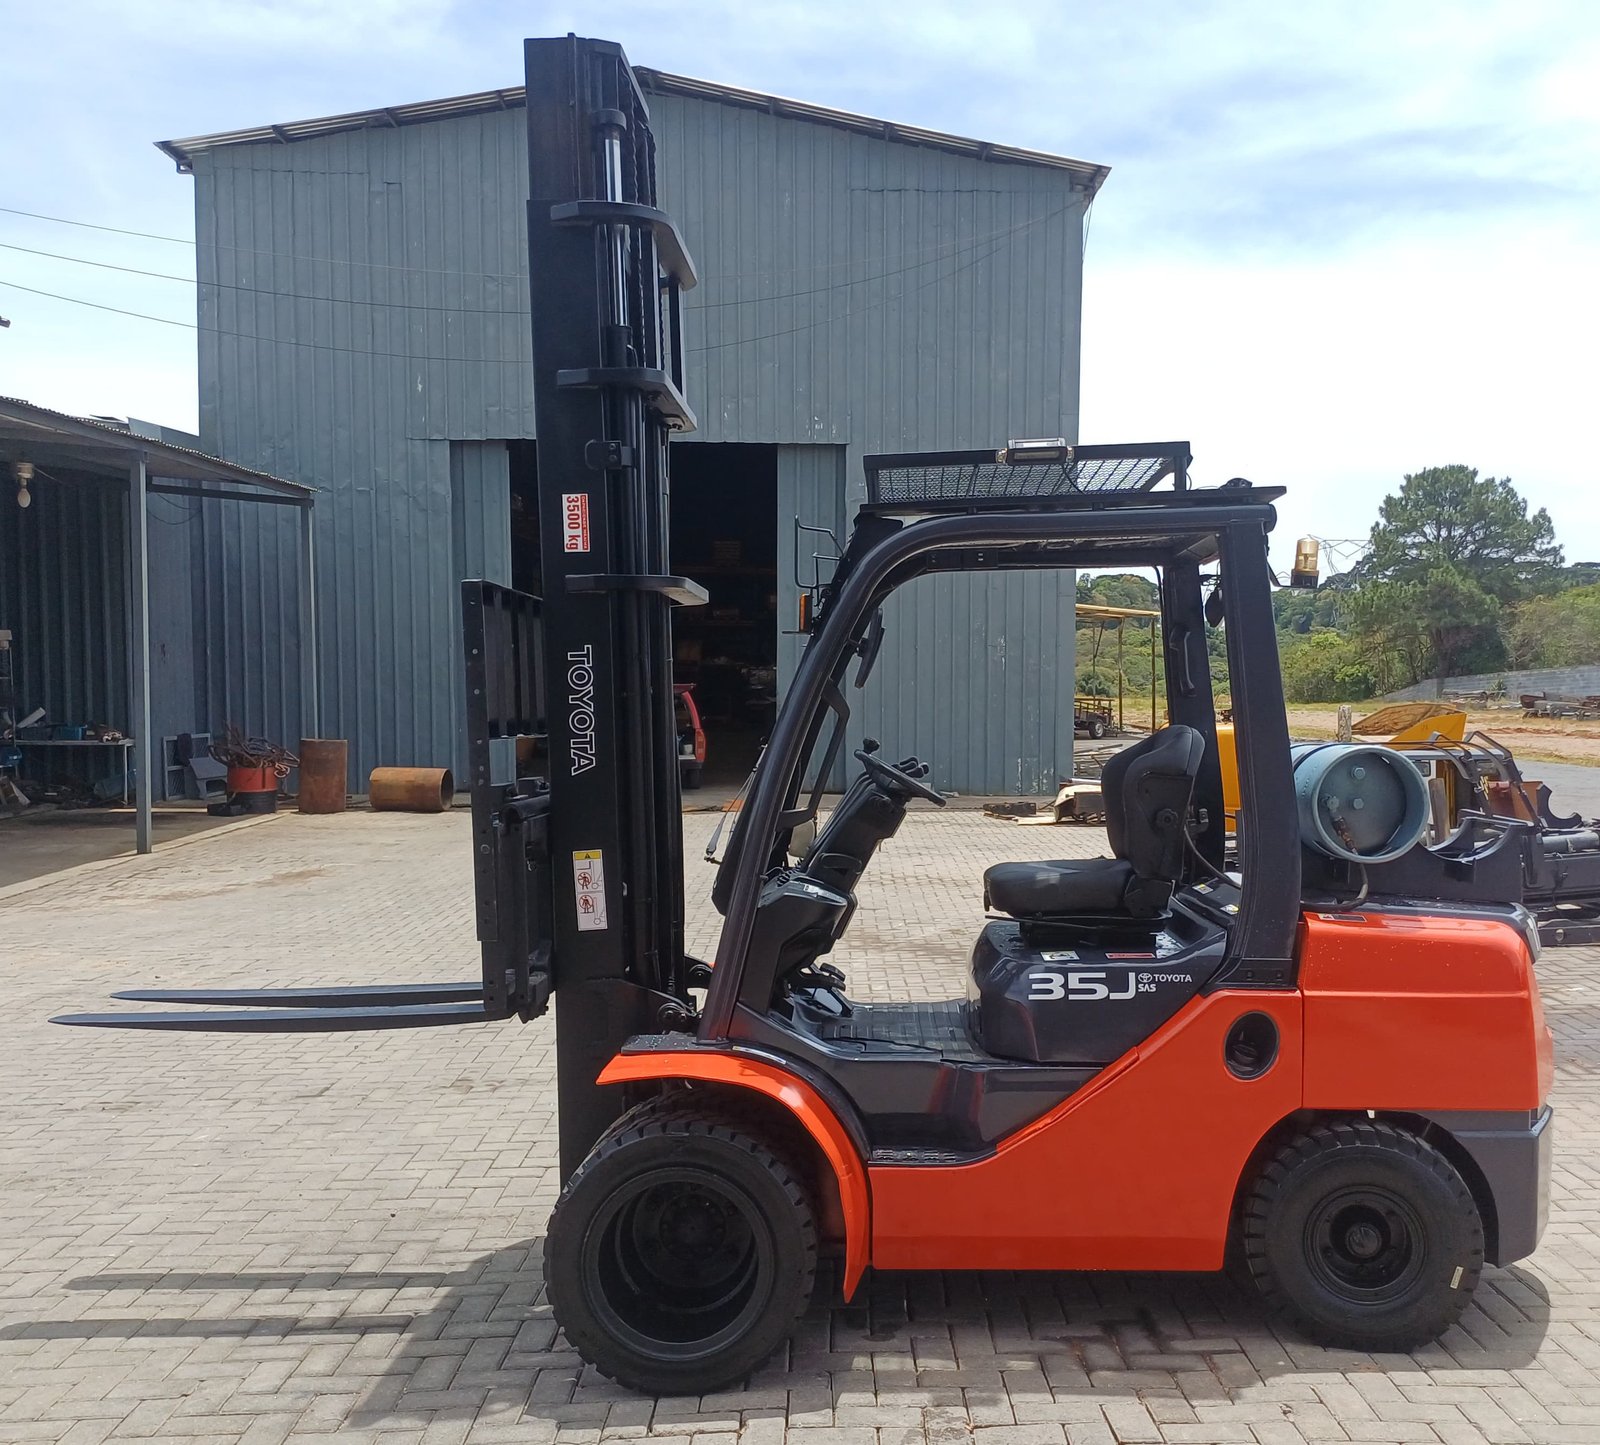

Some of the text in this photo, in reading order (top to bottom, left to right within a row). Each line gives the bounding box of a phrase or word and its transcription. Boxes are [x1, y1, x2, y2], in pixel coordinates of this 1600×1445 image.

[566, 496, 581, 550] 3500 kg
[568, 645, 595, 776] TOYOTA
[1028, 972, 1136, 1000] 35J
[1138, 983, 1156, 992] SAS
[1153, 974, 1192, 983] TOYOTA
